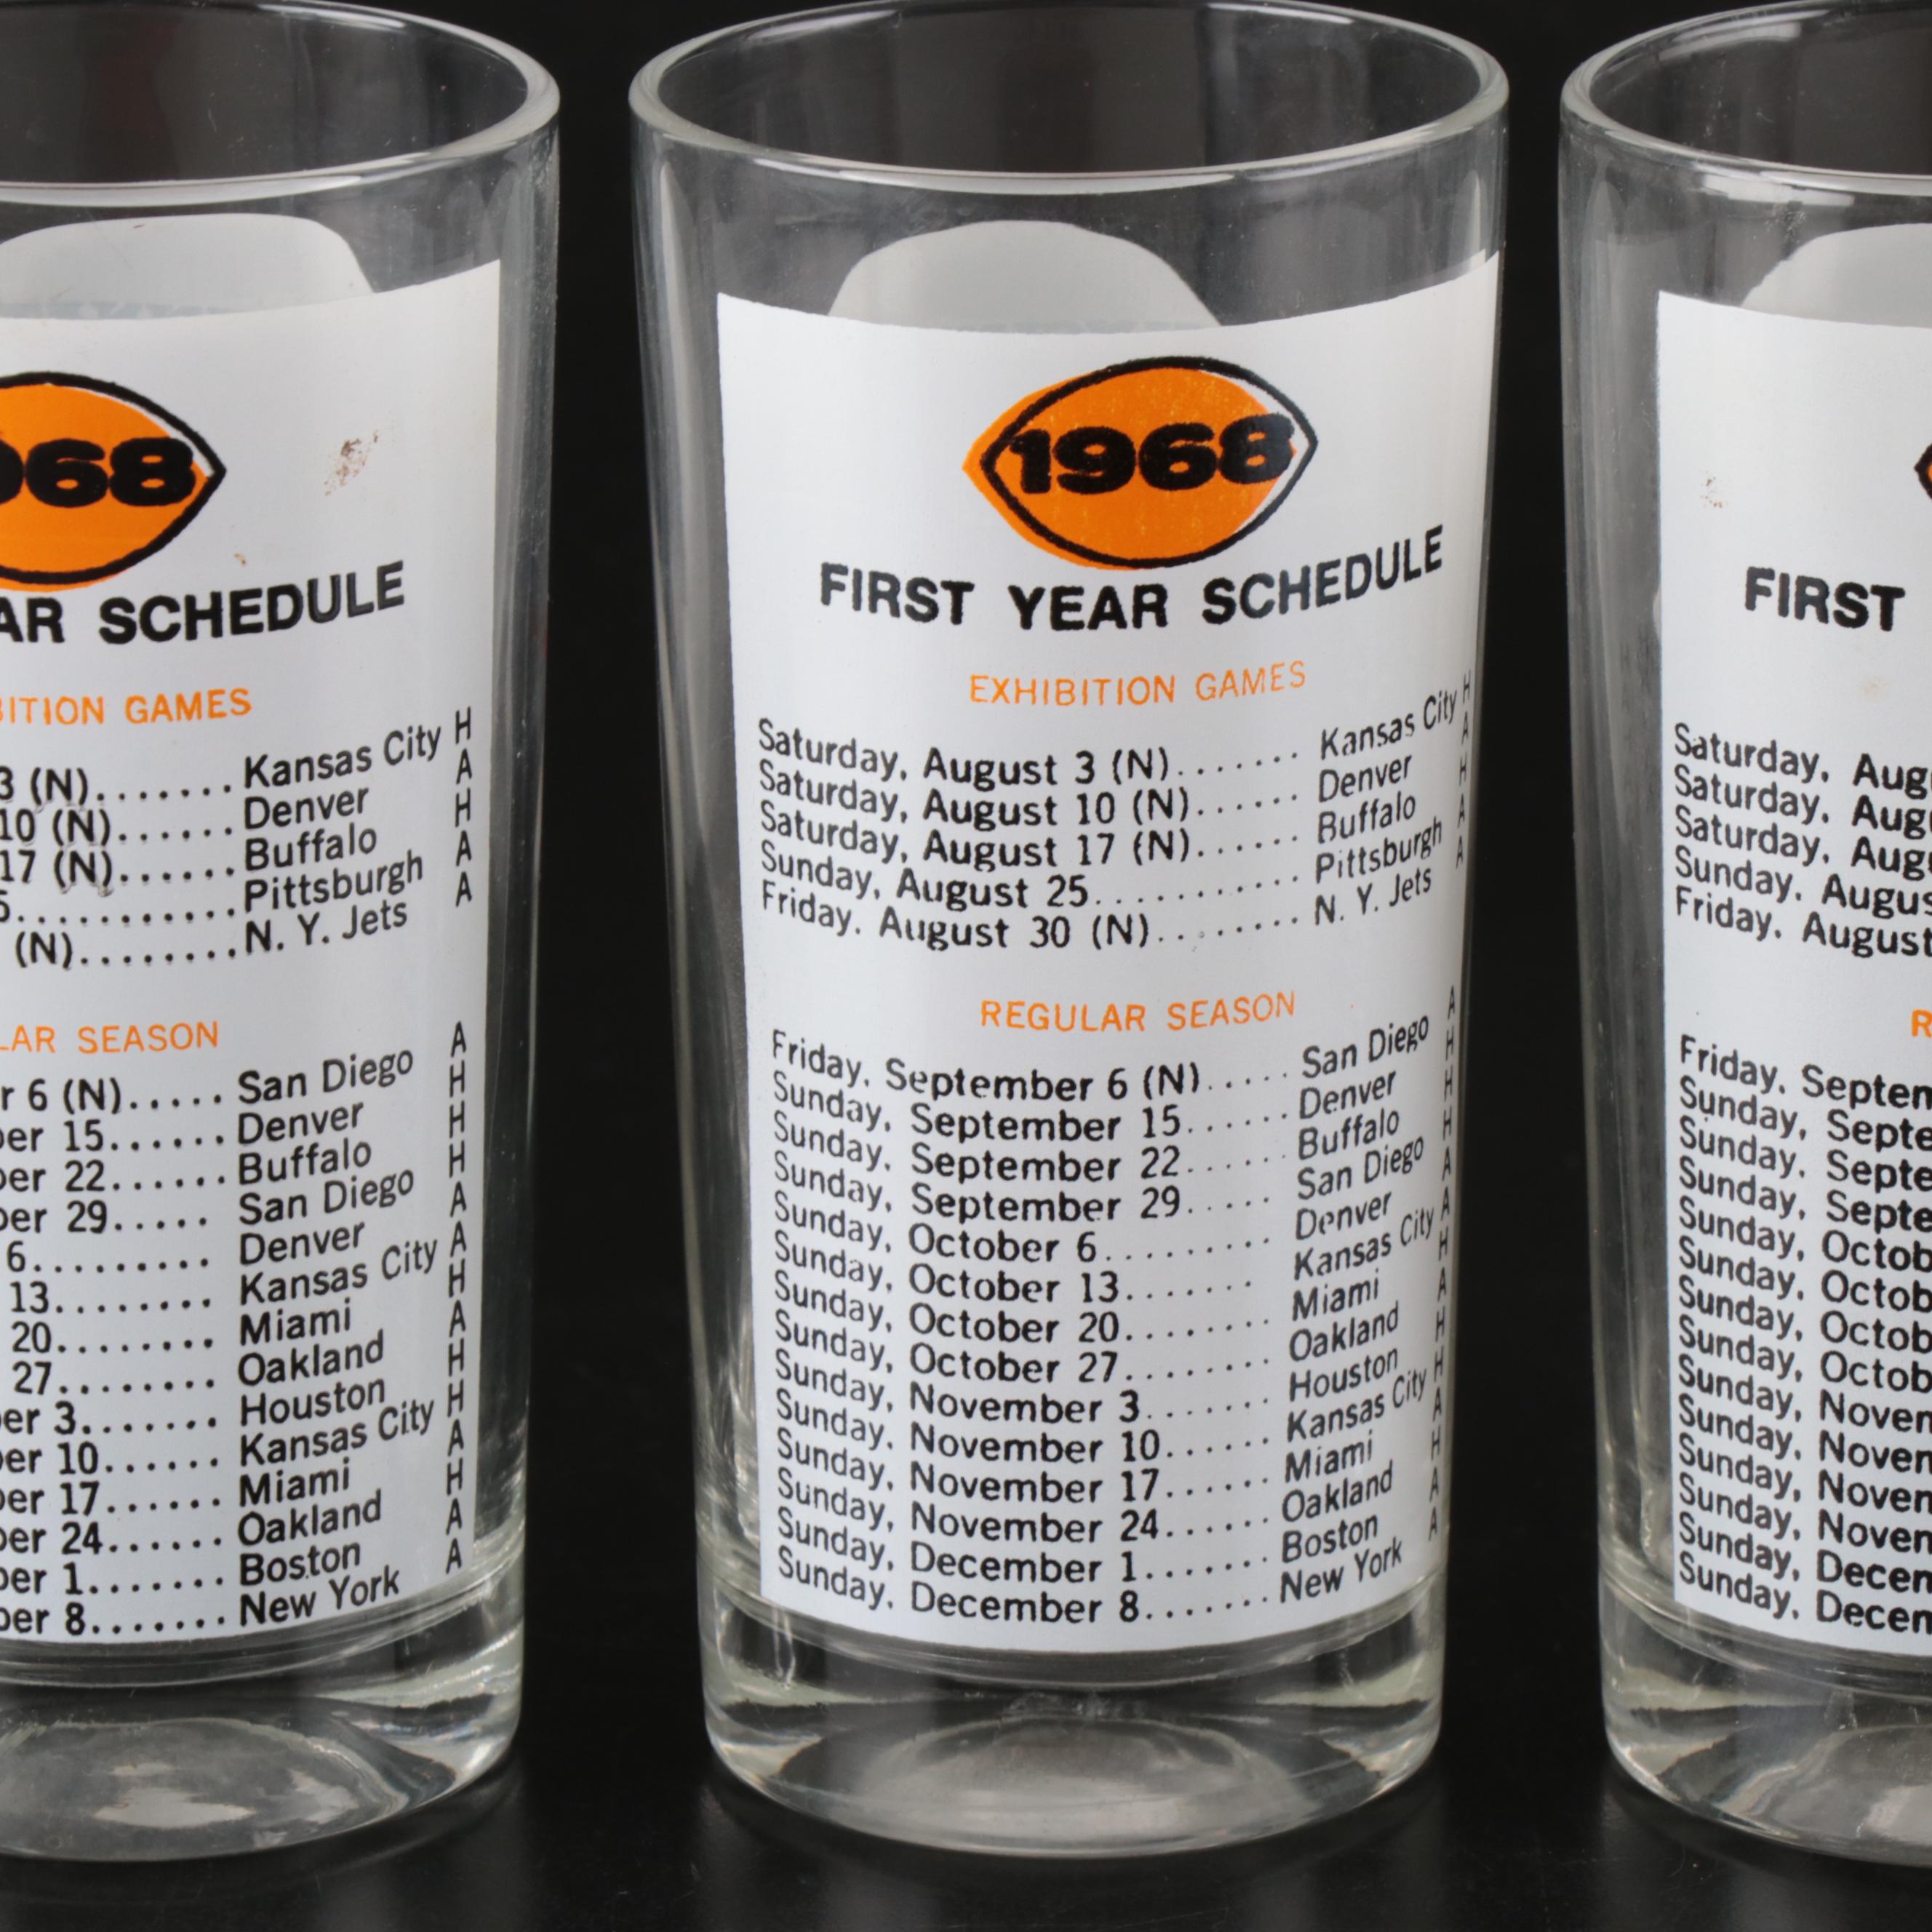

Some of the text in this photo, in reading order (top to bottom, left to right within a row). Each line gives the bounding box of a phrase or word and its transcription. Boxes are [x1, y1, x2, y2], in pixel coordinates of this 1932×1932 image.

[1009, 412, 1295, 495] 1968
[97, 559, 405, 645] SCHEDULE
[820, 524, 1443, 632] FIRST YEAR SCHEDULE
[1744, 566, 1907, 632] FIRST
[124, 687, 252, 725] GAMES
[922, 746, 1058, 793] August
[1320, 712, 1416, 761] Kansas
[1423, 690, 1458, 730] City
[1462, 671, 1471, 704] H
[970, 660, 1306, 707] EXHIBITION GAMES
[244, 706, 471, 790] Kansas City H
[922, 787, 1058, 833] August
[1318, 754, 1413, 803] Denver
[1461, 711, 1469, 745] A
[244, 787, 370, 831] Denver
[244, 821, 378, 872] Buffalo
[895, 867, 1029, 913] August
[1315, 815, 1442, 885] Pittsburgh
[1457, 793, 1466, 828] A
[922, 828, 1058, 873] August
[1317, 790, 1416, 845] Buffalo
[1458, 754, 1467, 786] H
[244, 829, 472, 914] Pittsburgh A
[879, 905, 1010, 952] August
[1314, 894, 1345, 926] N.
[1356, 882, 1378, 915] Y.
[1389, 867, 1432, 907] Jets
[1456, 835, 1464, 869] A
[77, 1020, 219, 1055] SEASON
[885, 1057, 1094, 1103] September
[1301, 1043, 1357, 1079] San
[1368, 1015, 1429, 1063] Diego
[1447, 985, 1456, 1021] A
[981, 991, 1295, 1033] REGULAR SEASON
[237, 1049, 414, 1105] San Diego
[910, 1101, 1122, 1145] September
[1298, 1070, 1397, 1120] Denver
[1445, 1026, 1454, 1061] H
[911, 1141, 1122, 1185] September
[1298, 1107, 1400, 1161] Buffalo
[1443, 1065, 1453, 1102] H
[908, 1222, 1061, 1264] October
[1295, 1191, 1392, 1241] Denver
[1441, 1146, 1452, 1181] A
[911, 1181, 1122, 1226] September
[1297, 1166, 1352, 1201] San
[1363, 1135, 1424, 1184] Diego
[1442, 1106, 1453, 1141] H
[909, 1262, 1061, 1304] October
[1293, 1232, 1392, 1281] Kansas
[1400, 1208, 1434, 1247] City
[1440, 1186, 1450, 1221] A
[909, 1301, 1061, 1344] October
[1292, 1277, 1379, 1322] Miami
[1438, 1226, 1449, 1261] H
[237, 1328, 384, 1387] Oakland
[239, 1296, 351, 1346] Miami
[909, 1341, 1061, 1384] October
[1288, 1300, 1399, 1362] Oakland
[1437, 1266, 1447, 1302] A
[909, 1380, 1103, 1424] November
[1288, 1348, 1398, 1402] Houston
[1434, 1306, 1446, 1343] H
[239, 1378, 386, 1427] Houston
[910, 1421, 1103, 1465] November
[1286, 1393, 1385, 1443] Kansas
[1392, 1368, 1427, 1409] City
[1433, 1345, 1444, 1382] H
[910, 1460, 1103, 1504] November
[1284, 1429, 1373, 1484] Miami
[1432, 1386, 1442, 1422] A
[910, 1540, 1103, 1584] December
[1281, 1514, 1378, 1564] Boston
[1429, 1466, 1440, 1502] A
[911, 1500, 1103, 1544] November
[1281, 1458, 1393, 1523] Oakland
[1430, 1425, 1441, 1461] H
[239, 1541, 361, 1587] Boston
[239, 1564, 400, 1628] New York
[911, 1580, 1103, 1624] December
[1280, 1565, 1344, 1604] New
[1354, 1536, 1402, 1582] York
[1428, 1506, 1438, 1541] A
